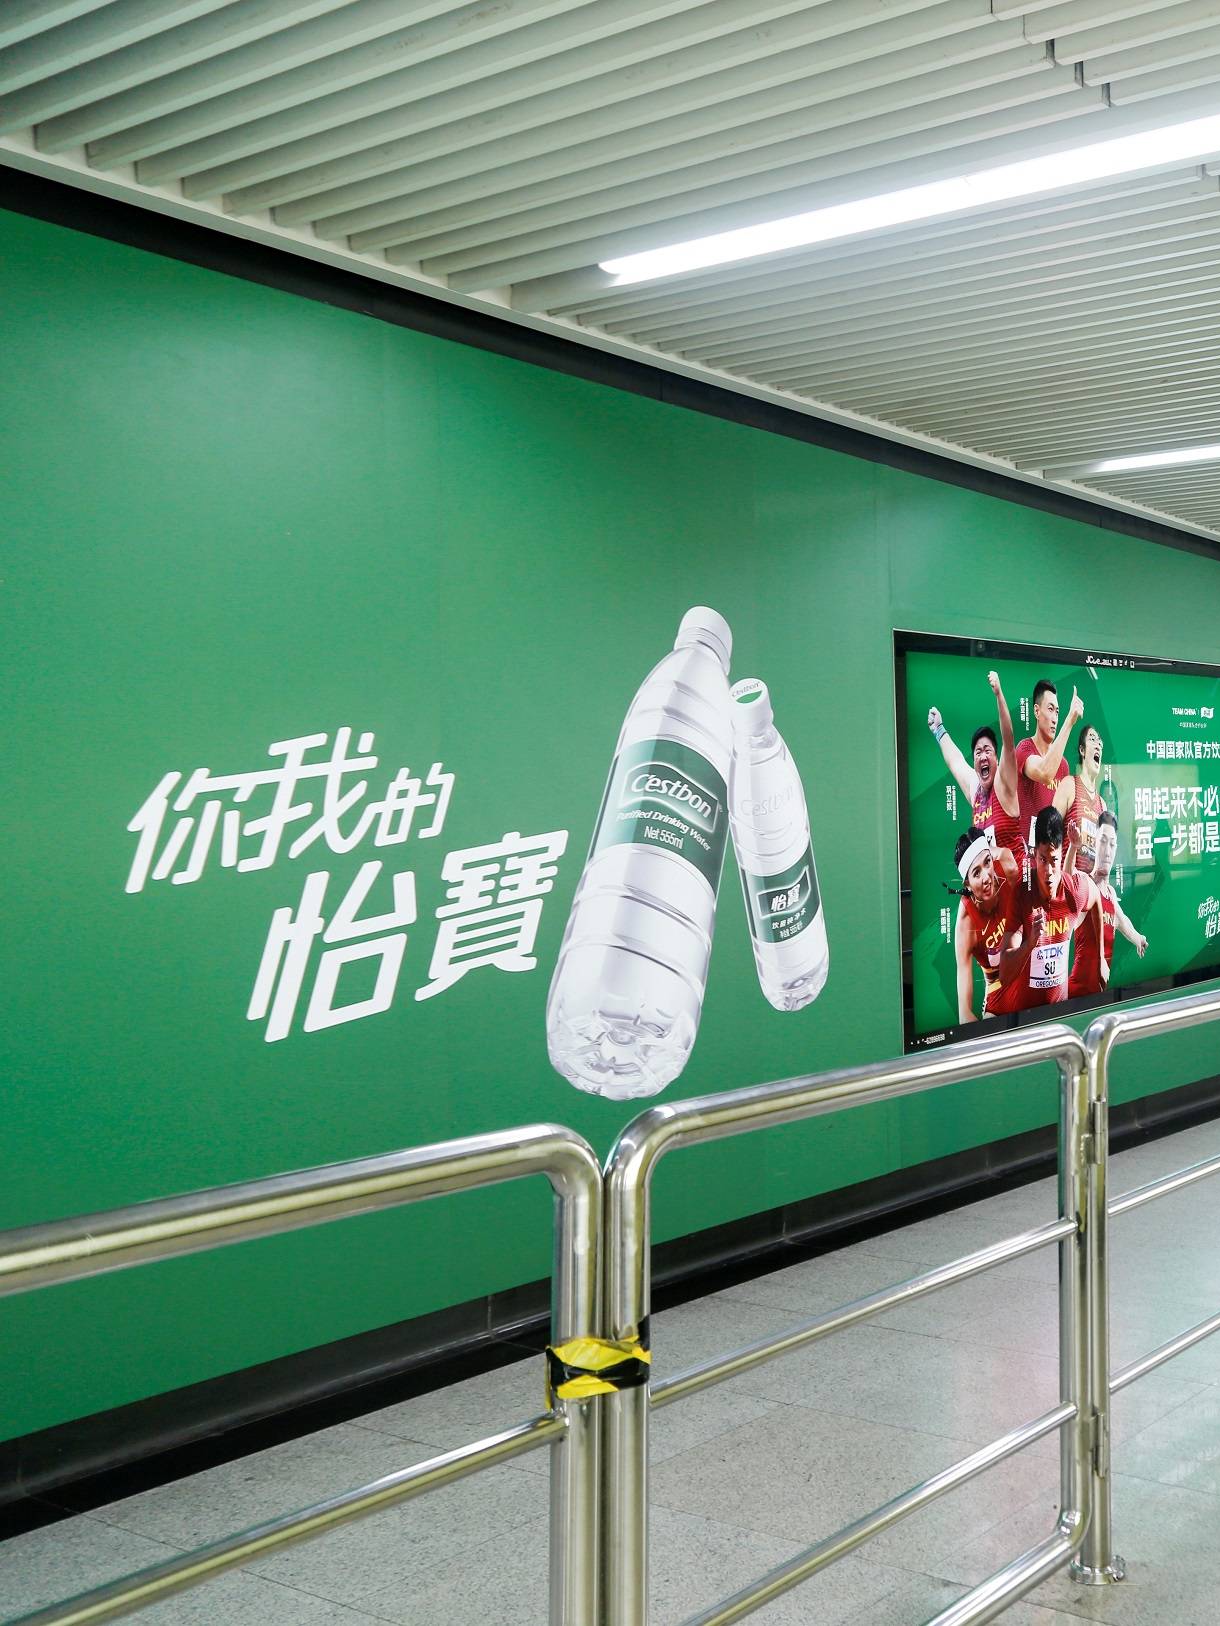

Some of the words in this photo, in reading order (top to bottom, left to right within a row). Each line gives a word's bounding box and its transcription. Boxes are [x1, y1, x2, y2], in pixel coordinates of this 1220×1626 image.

[125, 727, 455, 894] 你我的
[644, 825, 661, 840] Net
[659, 829, 685, 850] 555ml
[650, 811, 690, 834] Drinking
[689, 828, 712, 851] Water
[245, 829, 568, 1044] 怡寶
[1043, 946, 1064, 960] TDK
[1044, 961, 1056, 976] SU
